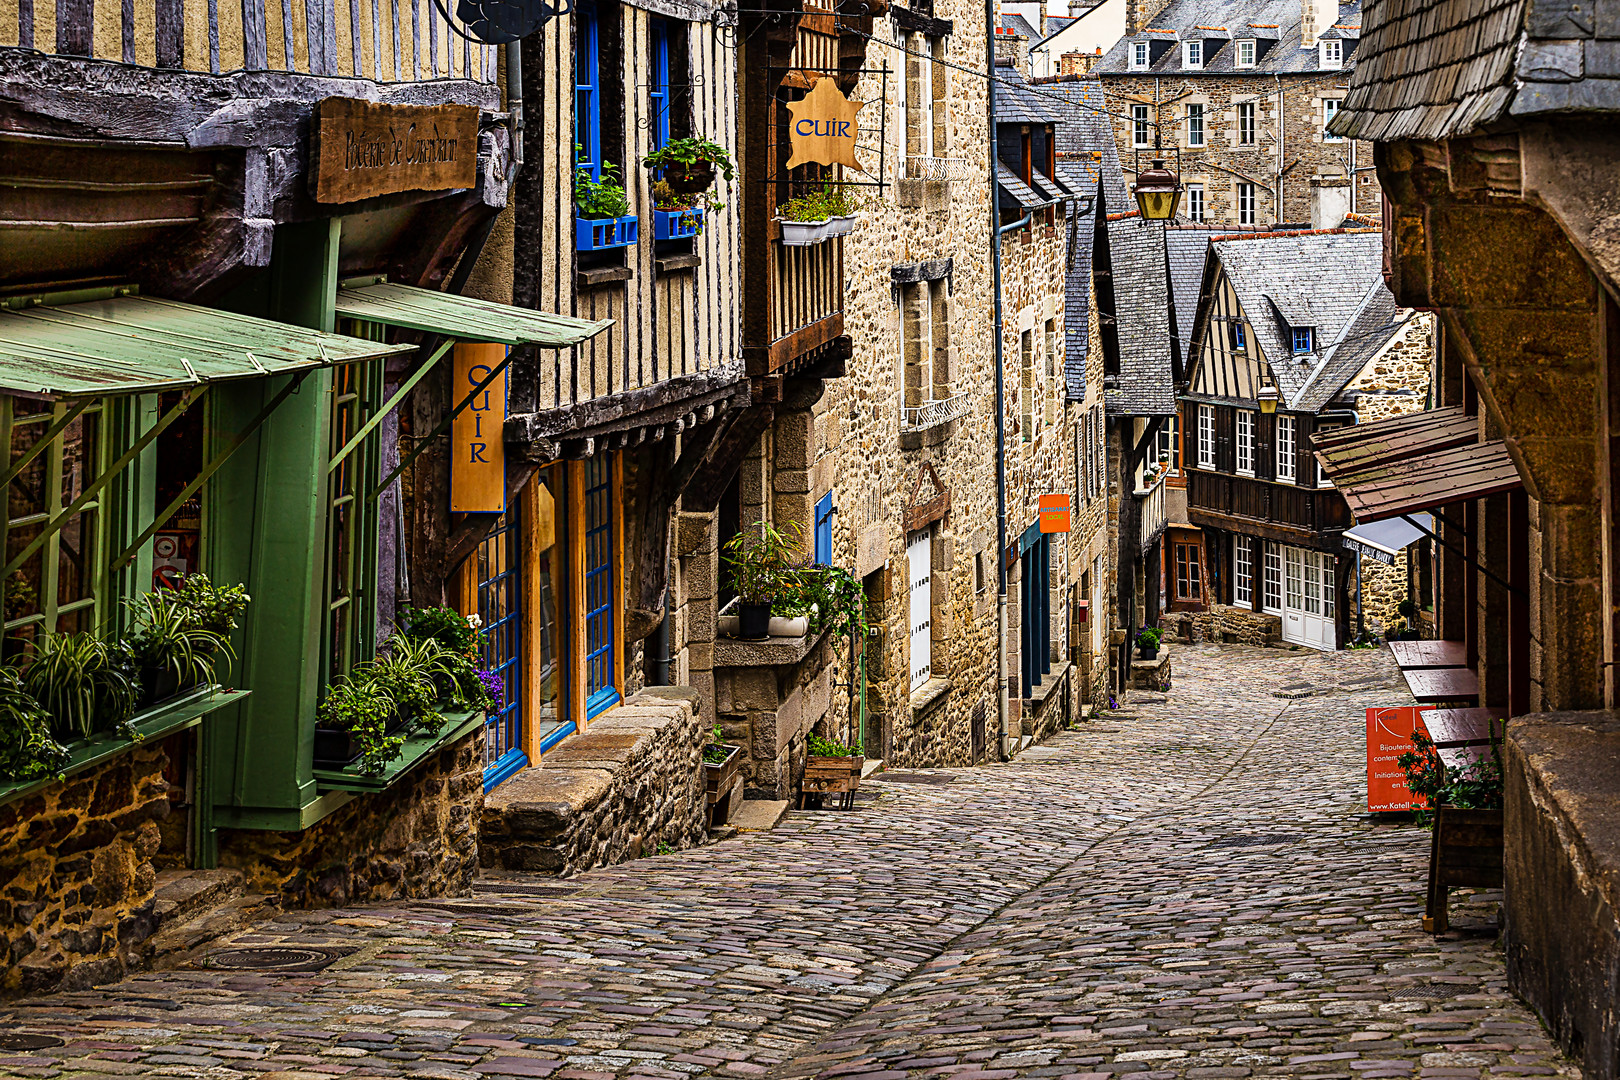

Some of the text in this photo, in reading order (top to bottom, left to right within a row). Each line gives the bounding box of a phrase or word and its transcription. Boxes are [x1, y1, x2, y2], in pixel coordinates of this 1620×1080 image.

[796, 117, 852, 138] CUIR
[388, 126, 403, 166] de
[467, 364, 492, 463] CUIR
[1374, 771, 1404, 779] Initiation
